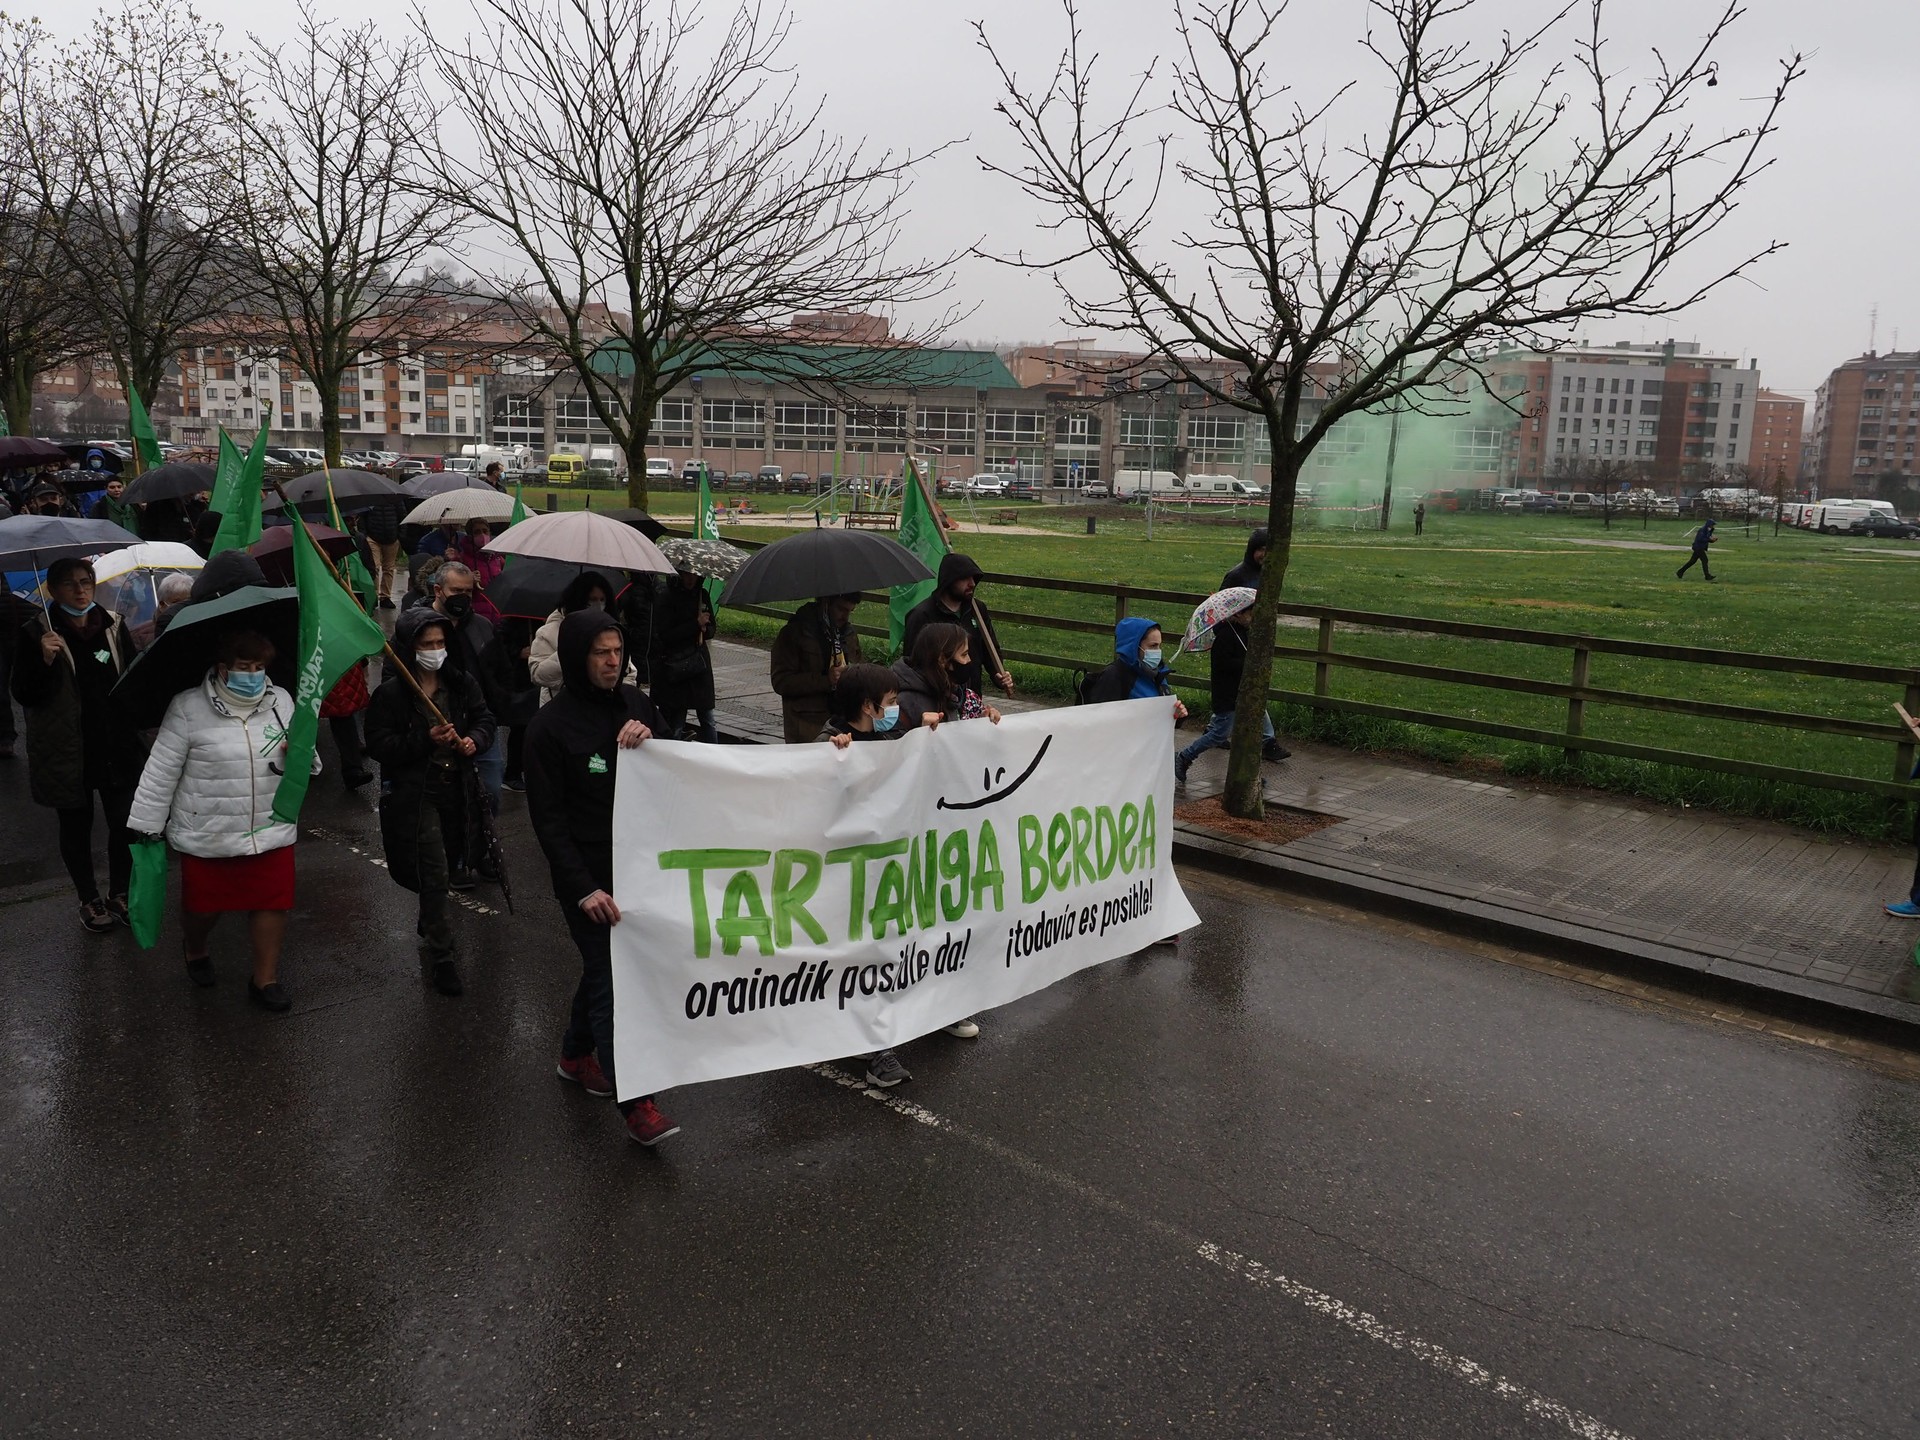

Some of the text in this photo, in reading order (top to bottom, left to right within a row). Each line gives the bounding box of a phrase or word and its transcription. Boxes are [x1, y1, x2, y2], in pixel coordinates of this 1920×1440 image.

[1006, 878, 1153, 968] ¡todavía es posible!
[685, 928, 971, 1020] oraindik posible da!
